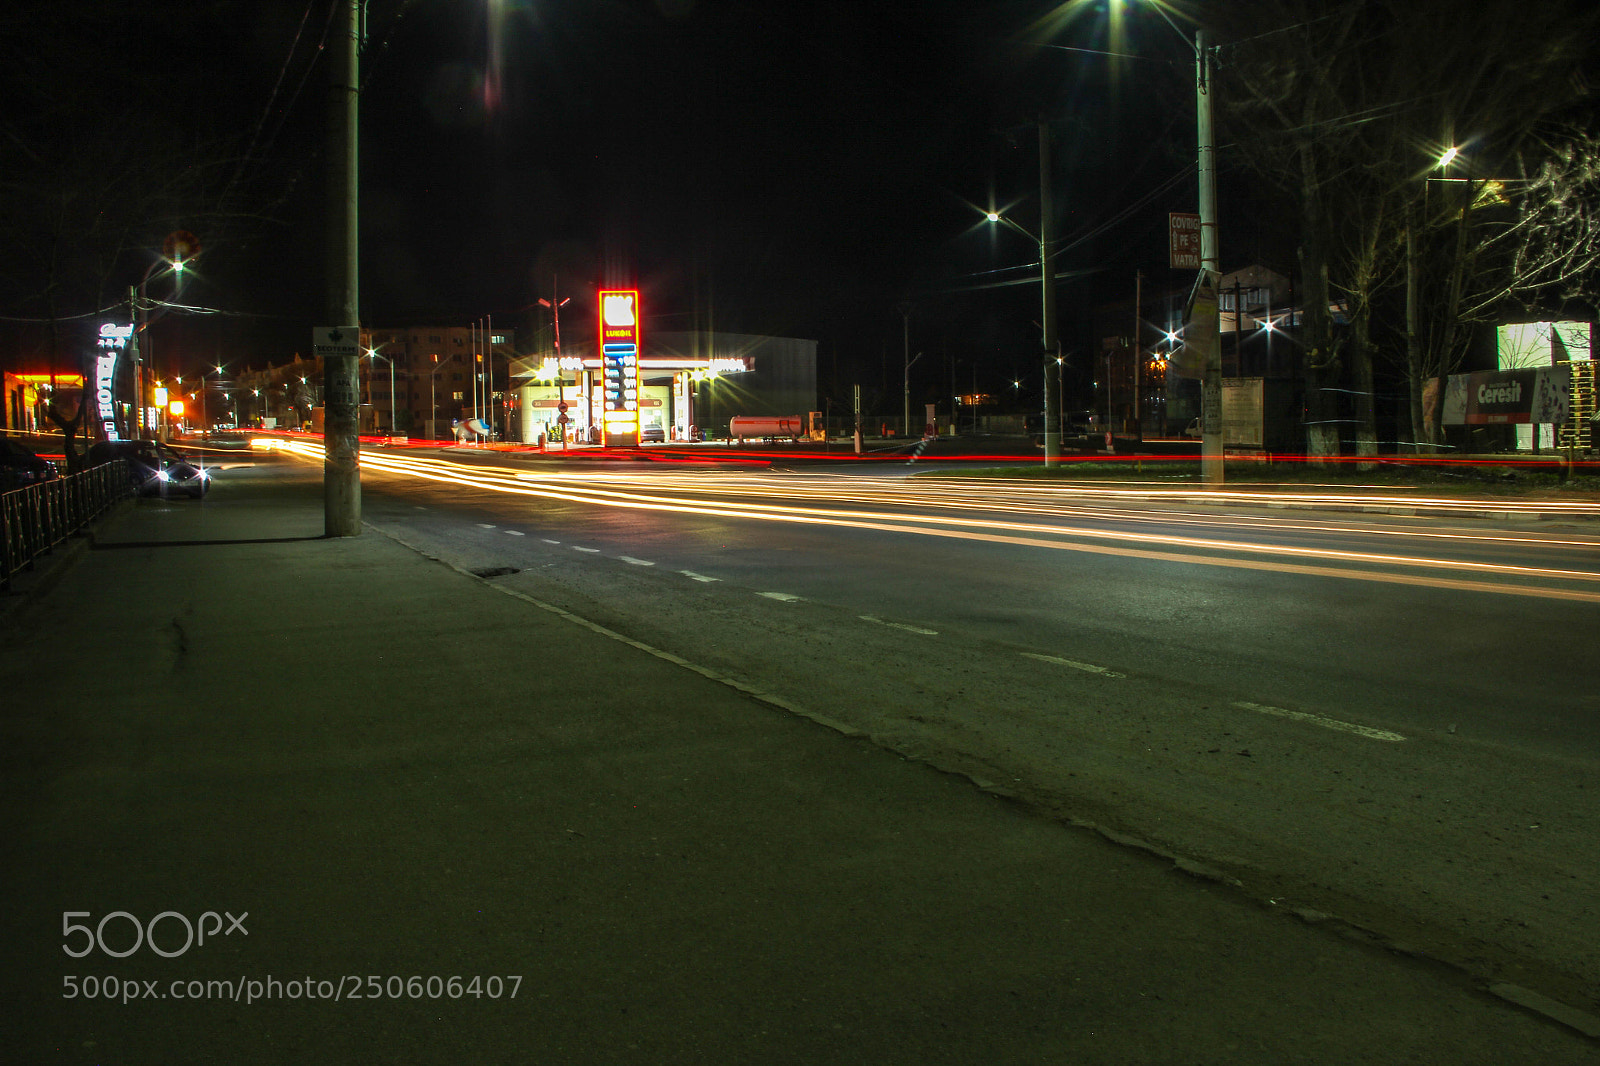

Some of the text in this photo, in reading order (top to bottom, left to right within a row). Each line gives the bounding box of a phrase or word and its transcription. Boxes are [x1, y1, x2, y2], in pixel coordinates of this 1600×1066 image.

[1171, 216, 1200, 230] COVRIGI
[1179, 234, 1189, 246] PE
[1174, 254, 1199, 266] VATRA
[605, 329, 632, 337] LUKOIL
[97, 352, 117, 419] HOTEL
[1478, 380, 1522, 404] Ceresit
